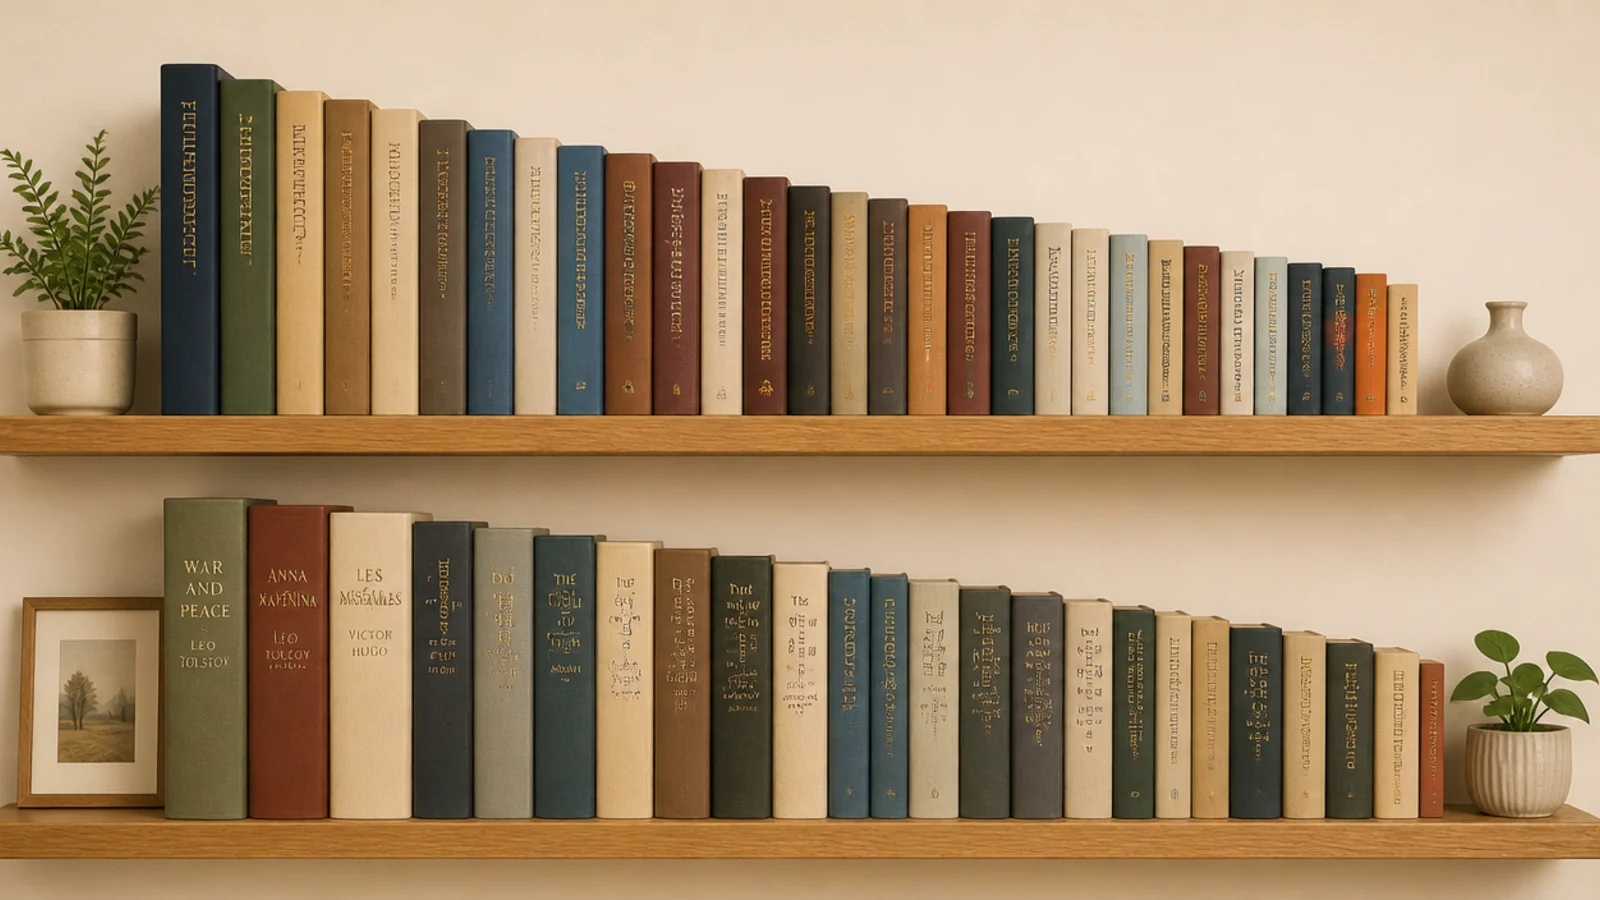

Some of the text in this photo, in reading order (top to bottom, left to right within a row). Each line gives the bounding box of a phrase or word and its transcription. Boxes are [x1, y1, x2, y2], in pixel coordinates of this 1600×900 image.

[184, 560, 223, 575] WAR
[267, 568, 308, 583] ANNA
[357, 568, 383, 583] LES
[185, 582, 224, 597] AND
[180, 604, 231, 619] PEACE
[348, 629, 393, 641] VICTOR
[190, 641, 216, 651] LEO
[351, 646, 388, 657] HUGO
